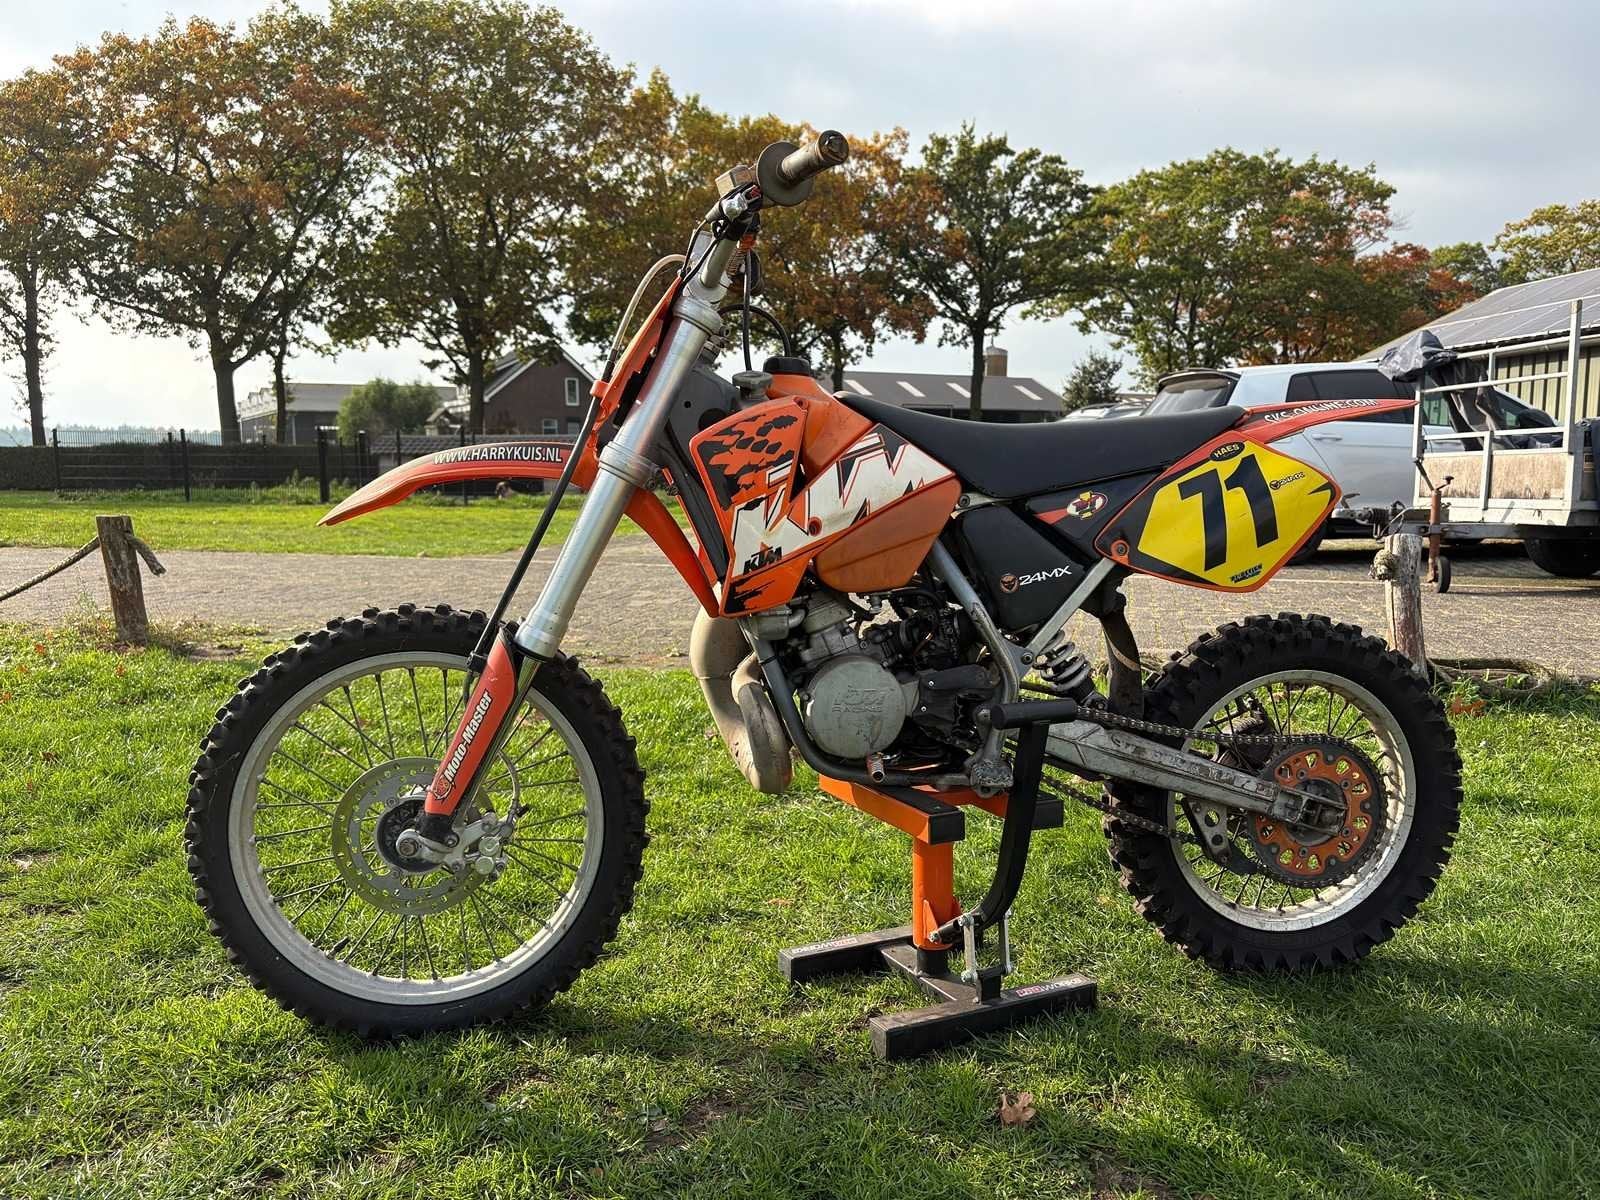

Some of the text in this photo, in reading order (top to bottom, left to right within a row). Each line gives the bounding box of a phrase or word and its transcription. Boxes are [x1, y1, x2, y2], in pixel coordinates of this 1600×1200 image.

[432, 446, 562, 465] WWW.HARRYKUIS.NL
[1213, 443, 1240, 458] HAES
[1177, 453, 1280, 572] 71
[742, 545, 783, 576] KTM
[1018, 565, 1073, 596] 24MX
[443, 690, 494, 784] Moto-Master
